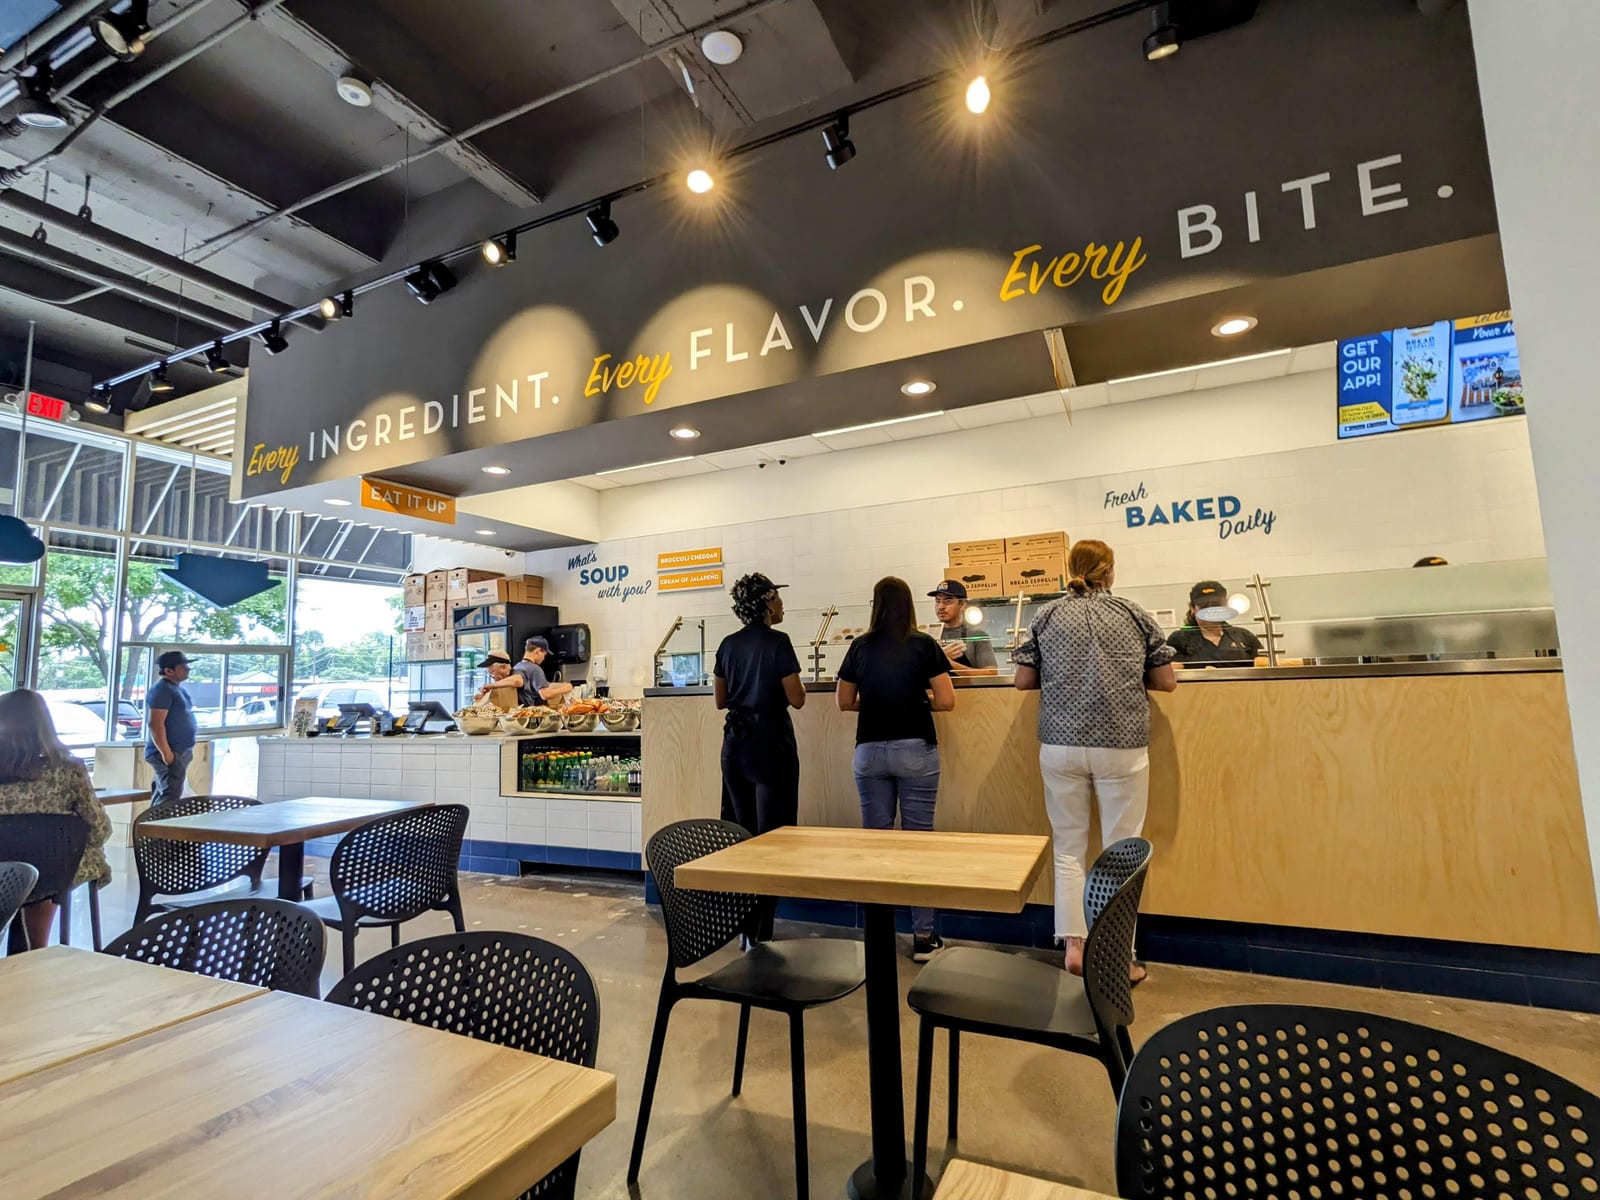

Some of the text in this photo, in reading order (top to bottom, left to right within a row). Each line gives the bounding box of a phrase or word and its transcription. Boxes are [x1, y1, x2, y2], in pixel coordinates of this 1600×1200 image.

[246, 153, 1455, 485] Every INGREDIENT. Every FLAVOR. Every BITE.
[1343, 338, 1379, 358] GET
[1343, 356, 1381, 375] OUR
[1343, 373, 1382, 392] APP!
[33, 397, 66, 418] EXIT
[371, 486, 447, 514] EAT IT UP
[1103, 481, 1149, 510] Fresh
[1125, 495, 1242, 529] BAKED
[1218, 508, 1277, 540] Daily
[567, 550, 598, 571] What's
[660, 552, 718, 564] BROCCOLI CHEDDAR
[579, 564, 630, 586] SOUP
[597, 579, 652, 603] with you?
